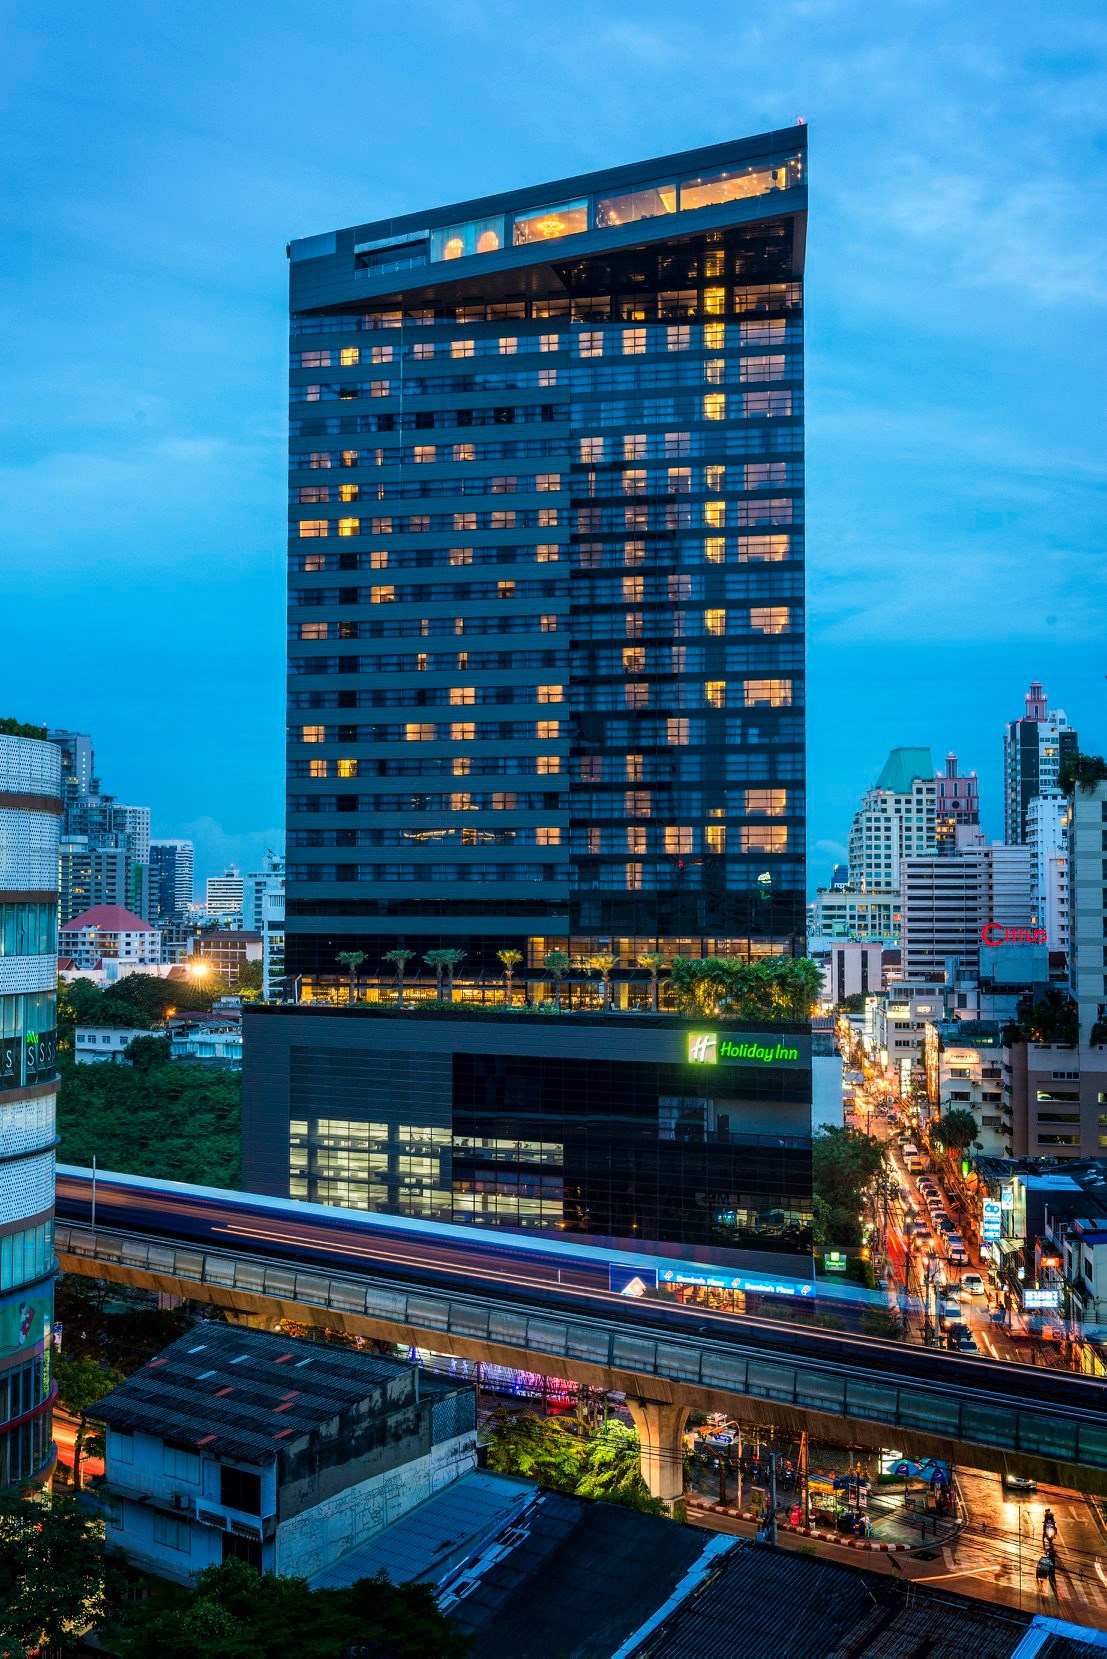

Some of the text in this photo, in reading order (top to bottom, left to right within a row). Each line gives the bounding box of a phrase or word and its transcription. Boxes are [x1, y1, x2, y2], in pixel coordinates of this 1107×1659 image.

[720, 1041, 798, 1062] Holiday Inn
[676, 1274, 725, 1287] Domino's Pizza
[744, 1282, 795, 1295] Domino's Pizza
